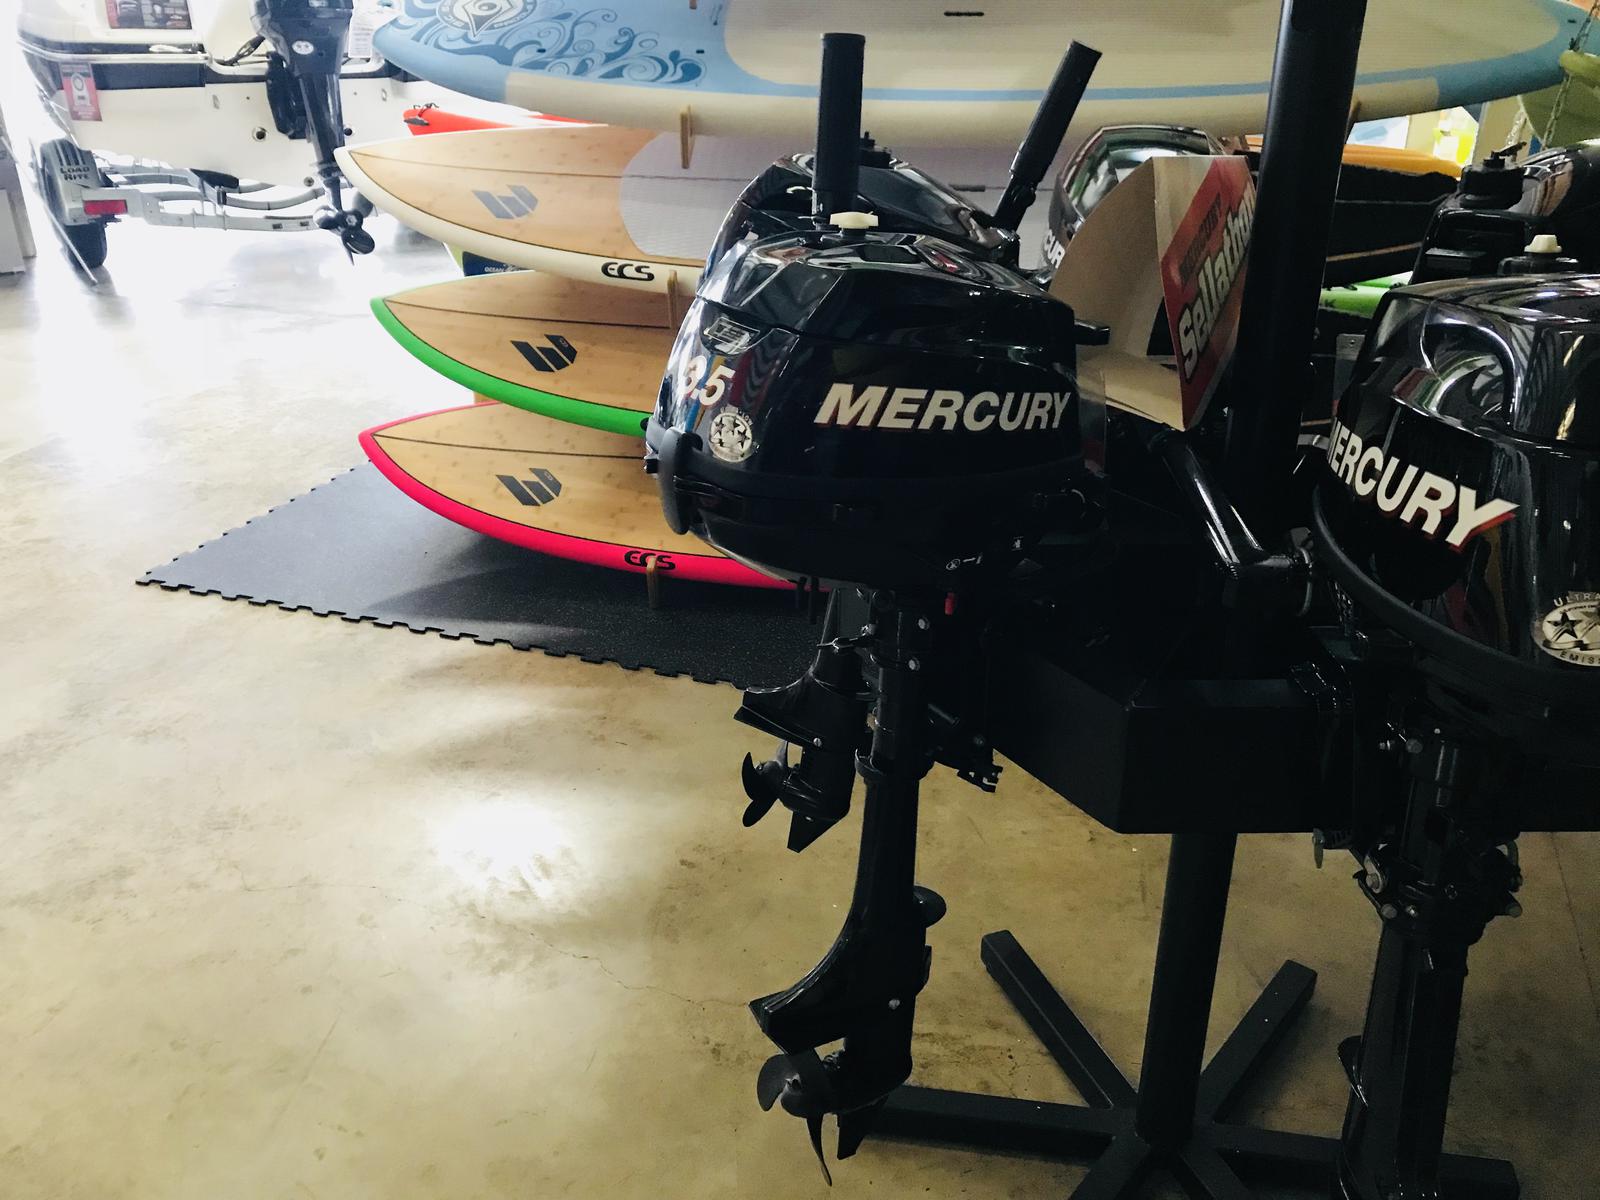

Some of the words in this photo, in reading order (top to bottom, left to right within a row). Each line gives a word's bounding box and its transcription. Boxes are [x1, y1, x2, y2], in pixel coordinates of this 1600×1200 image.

[601, 262, 655, 281] ECS
[813, 382, 1071, 432] MERCURY
[1560, 650, 1600, 665] EMIS
